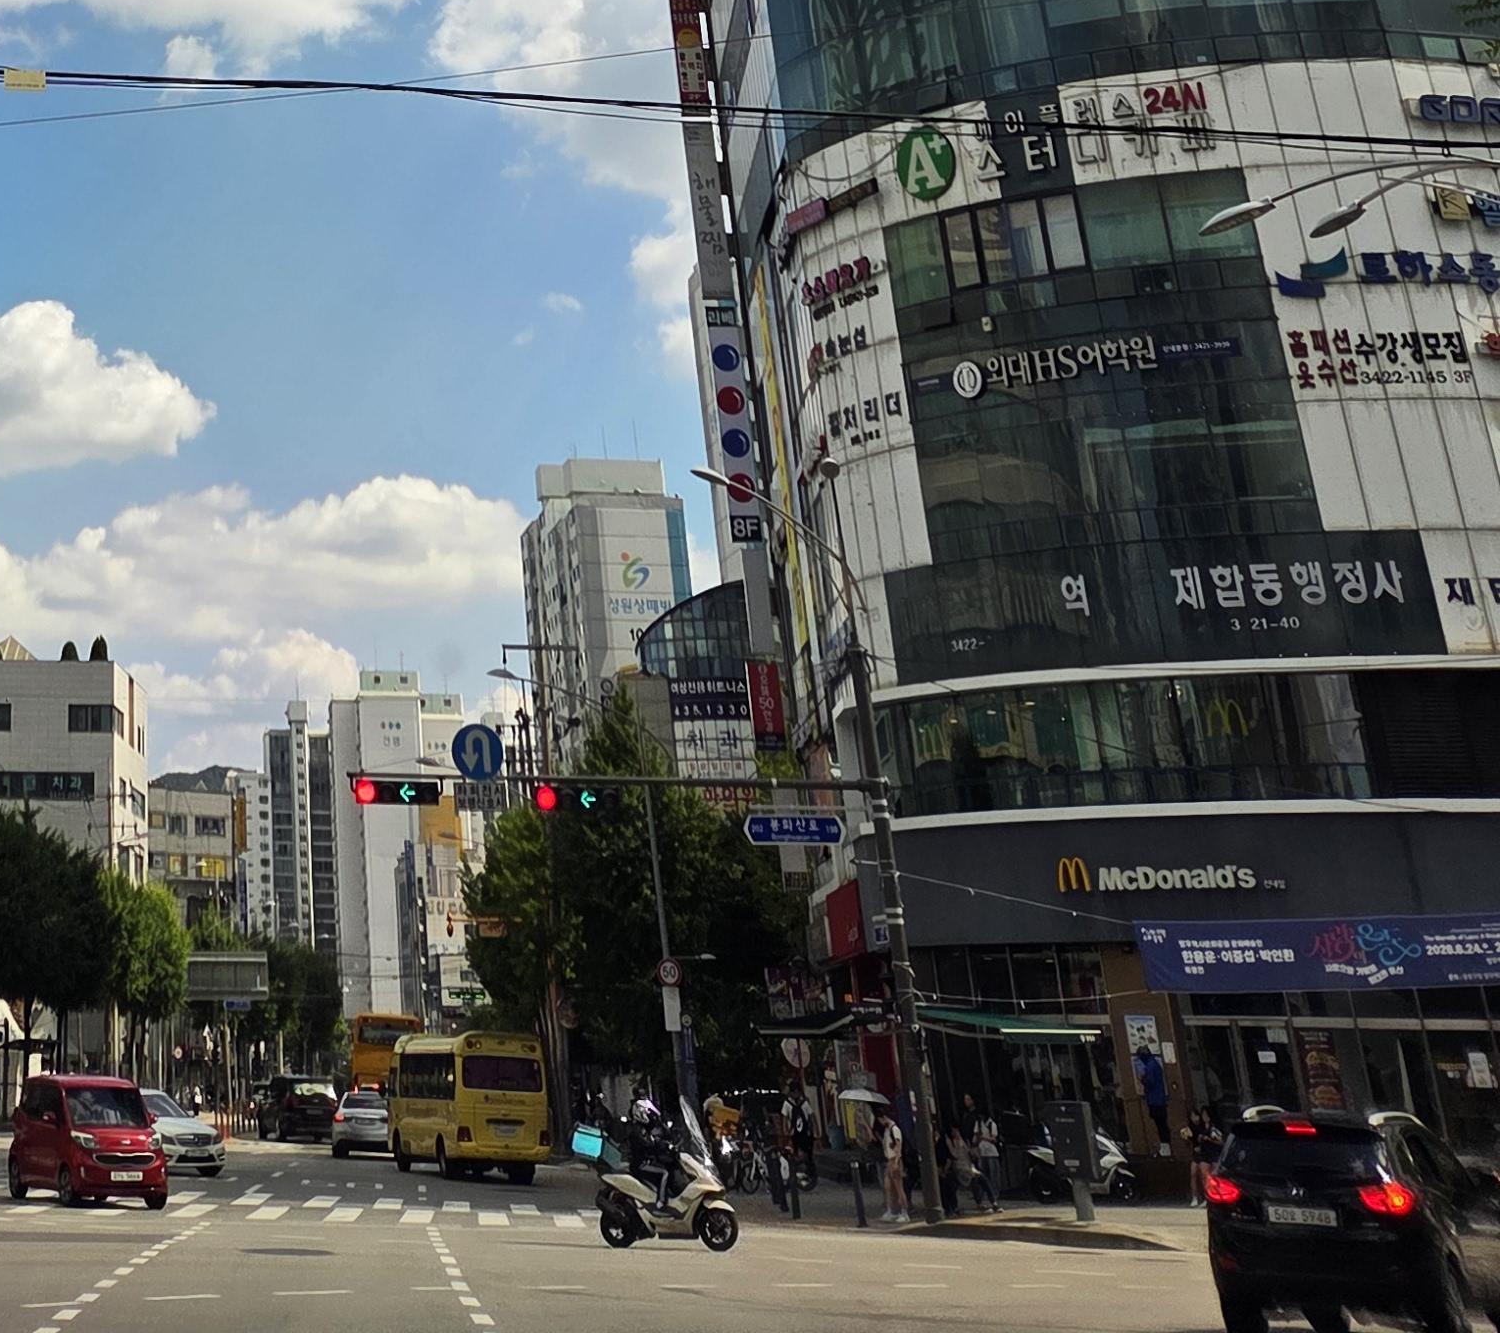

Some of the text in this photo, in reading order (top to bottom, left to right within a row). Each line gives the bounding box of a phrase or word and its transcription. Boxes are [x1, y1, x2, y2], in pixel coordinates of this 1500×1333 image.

[986, 335, 1159, 385] 외대HS어학원
[1356, 331, 1469, 364] 수강생모집
[1360, 369, 1447, 384] 3422-1145
[733, 517, 761, 539] 8F
[1098, 864, 1257, 892] McDonald's
